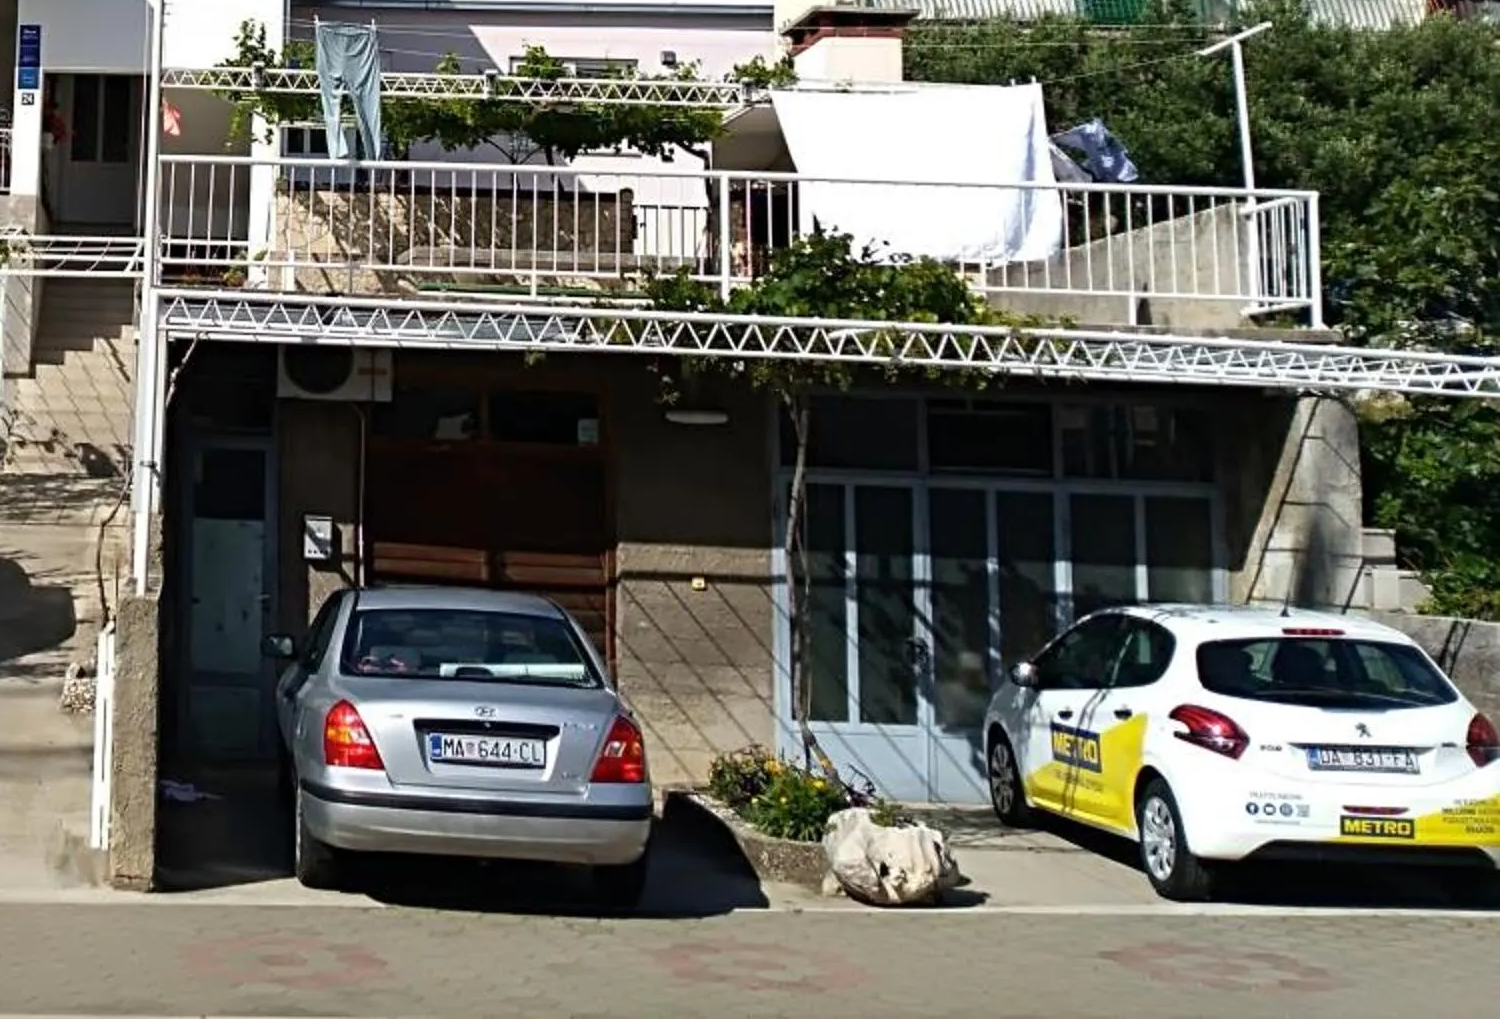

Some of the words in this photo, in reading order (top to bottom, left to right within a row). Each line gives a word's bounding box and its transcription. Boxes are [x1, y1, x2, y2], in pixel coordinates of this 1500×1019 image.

[443, 738, 465, 757] MA
[1053, 730, 1098, 764] METRO
[1343, 818, 1411, 835] METRO
